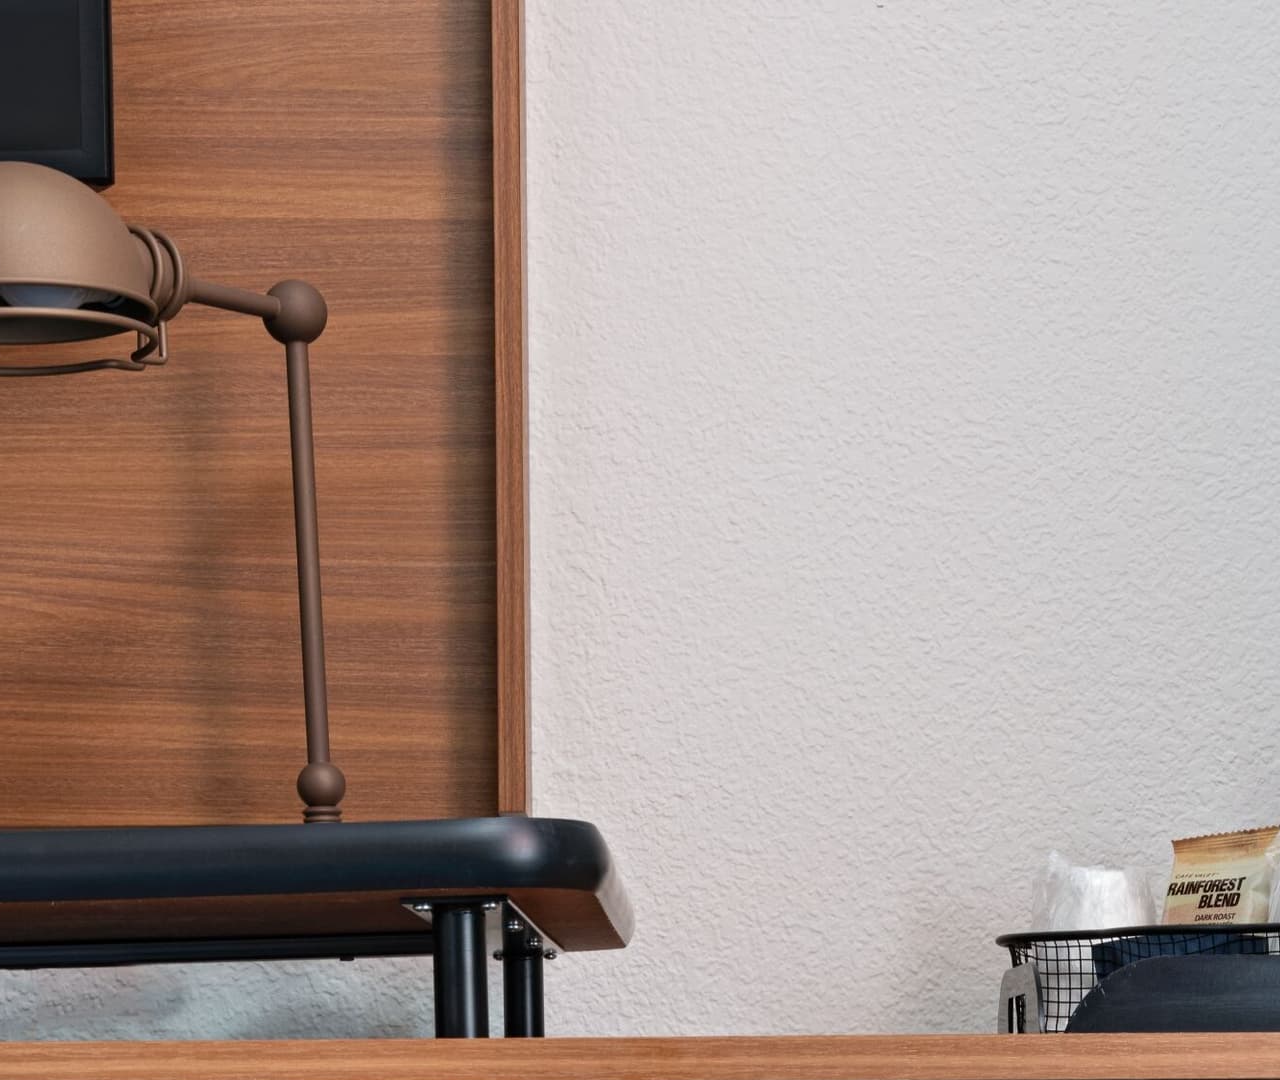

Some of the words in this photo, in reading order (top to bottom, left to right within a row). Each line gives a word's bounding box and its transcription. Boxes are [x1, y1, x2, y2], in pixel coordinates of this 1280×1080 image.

[1167, 877, 1246, 896] RAINFOREST
[1198, 893, 1241, 909] BLEND
[1194, 914, 1213, 922] DARK
[1213, 913, 1236, 921] ROAST
